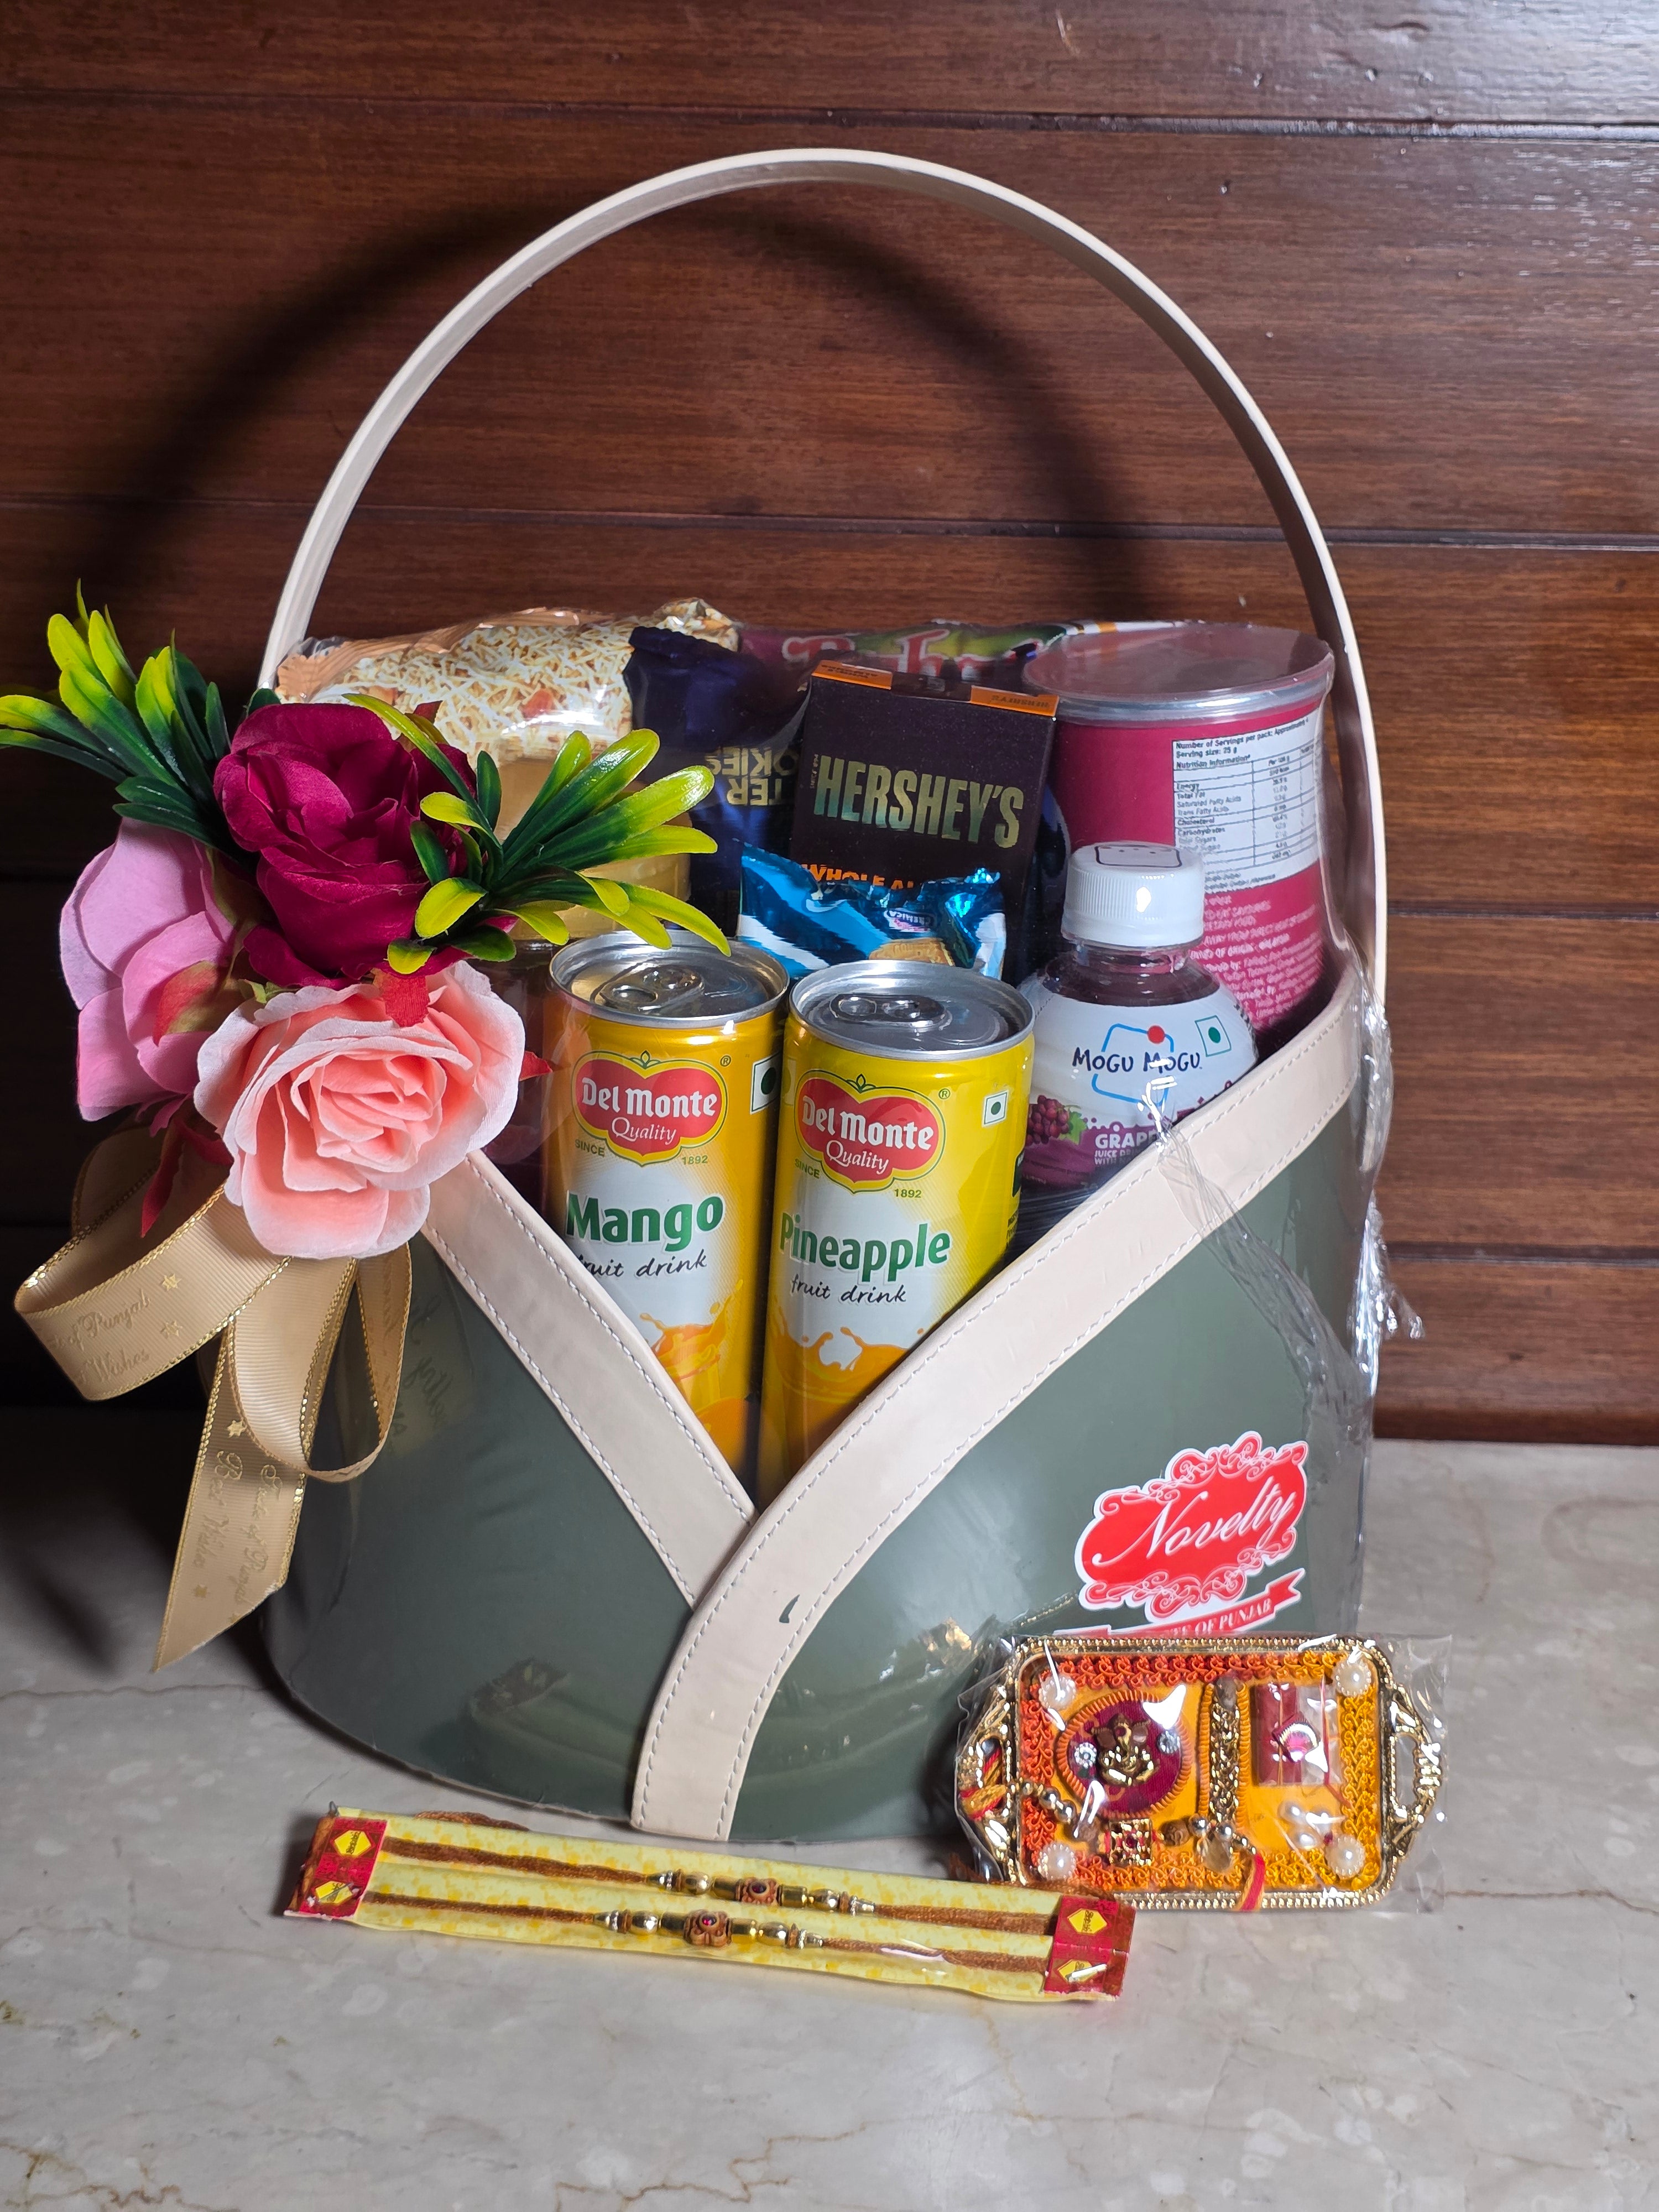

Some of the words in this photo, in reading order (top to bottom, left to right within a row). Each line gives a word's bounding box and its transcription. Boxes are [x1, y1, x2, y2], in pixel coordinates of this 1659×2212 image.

[1176, 750, 1203, 759] Serving
[1214, 737, 1244, 747] Servings
[1176, 760, 1208, 769] Nutrition
[813, 754, 1024, 849] HERSHEY'S
[1072, 1046, 1134, 1073] MOGU
[581, 1077, 621, 1113] Del
[625, 1087, 718, 1118] Monte
[611, 1116, 677, 1146] Quality
[802, 1095, 836, 1136] Del
[839, 1110, 935, 1151] Monte
[574, 1138, 606, 1157] SINCE
[681, 1155, 708, 1166] 1892
[826, 1139, 890, 1176] Quality
[1094, 1150, 1118, 1159] JUICE
[794, 1158, 821, 1180] SINCE
[894, 1188, 922, 1199] 1892
[565, 1192, 725, 1253] Mango
[636, 1249, 707, 1277] drink
[779, 1212, 951, 1283] Pineapple
[791, 1273, 832, 1299] fruit
[840, 1284, 907, 1303] drink
[1092, 1475, 1297, 1567] Novelty
[1194, 1618, 1217, 1635] OF
[1219, 1597, 1272, 1631] PUNJAB
